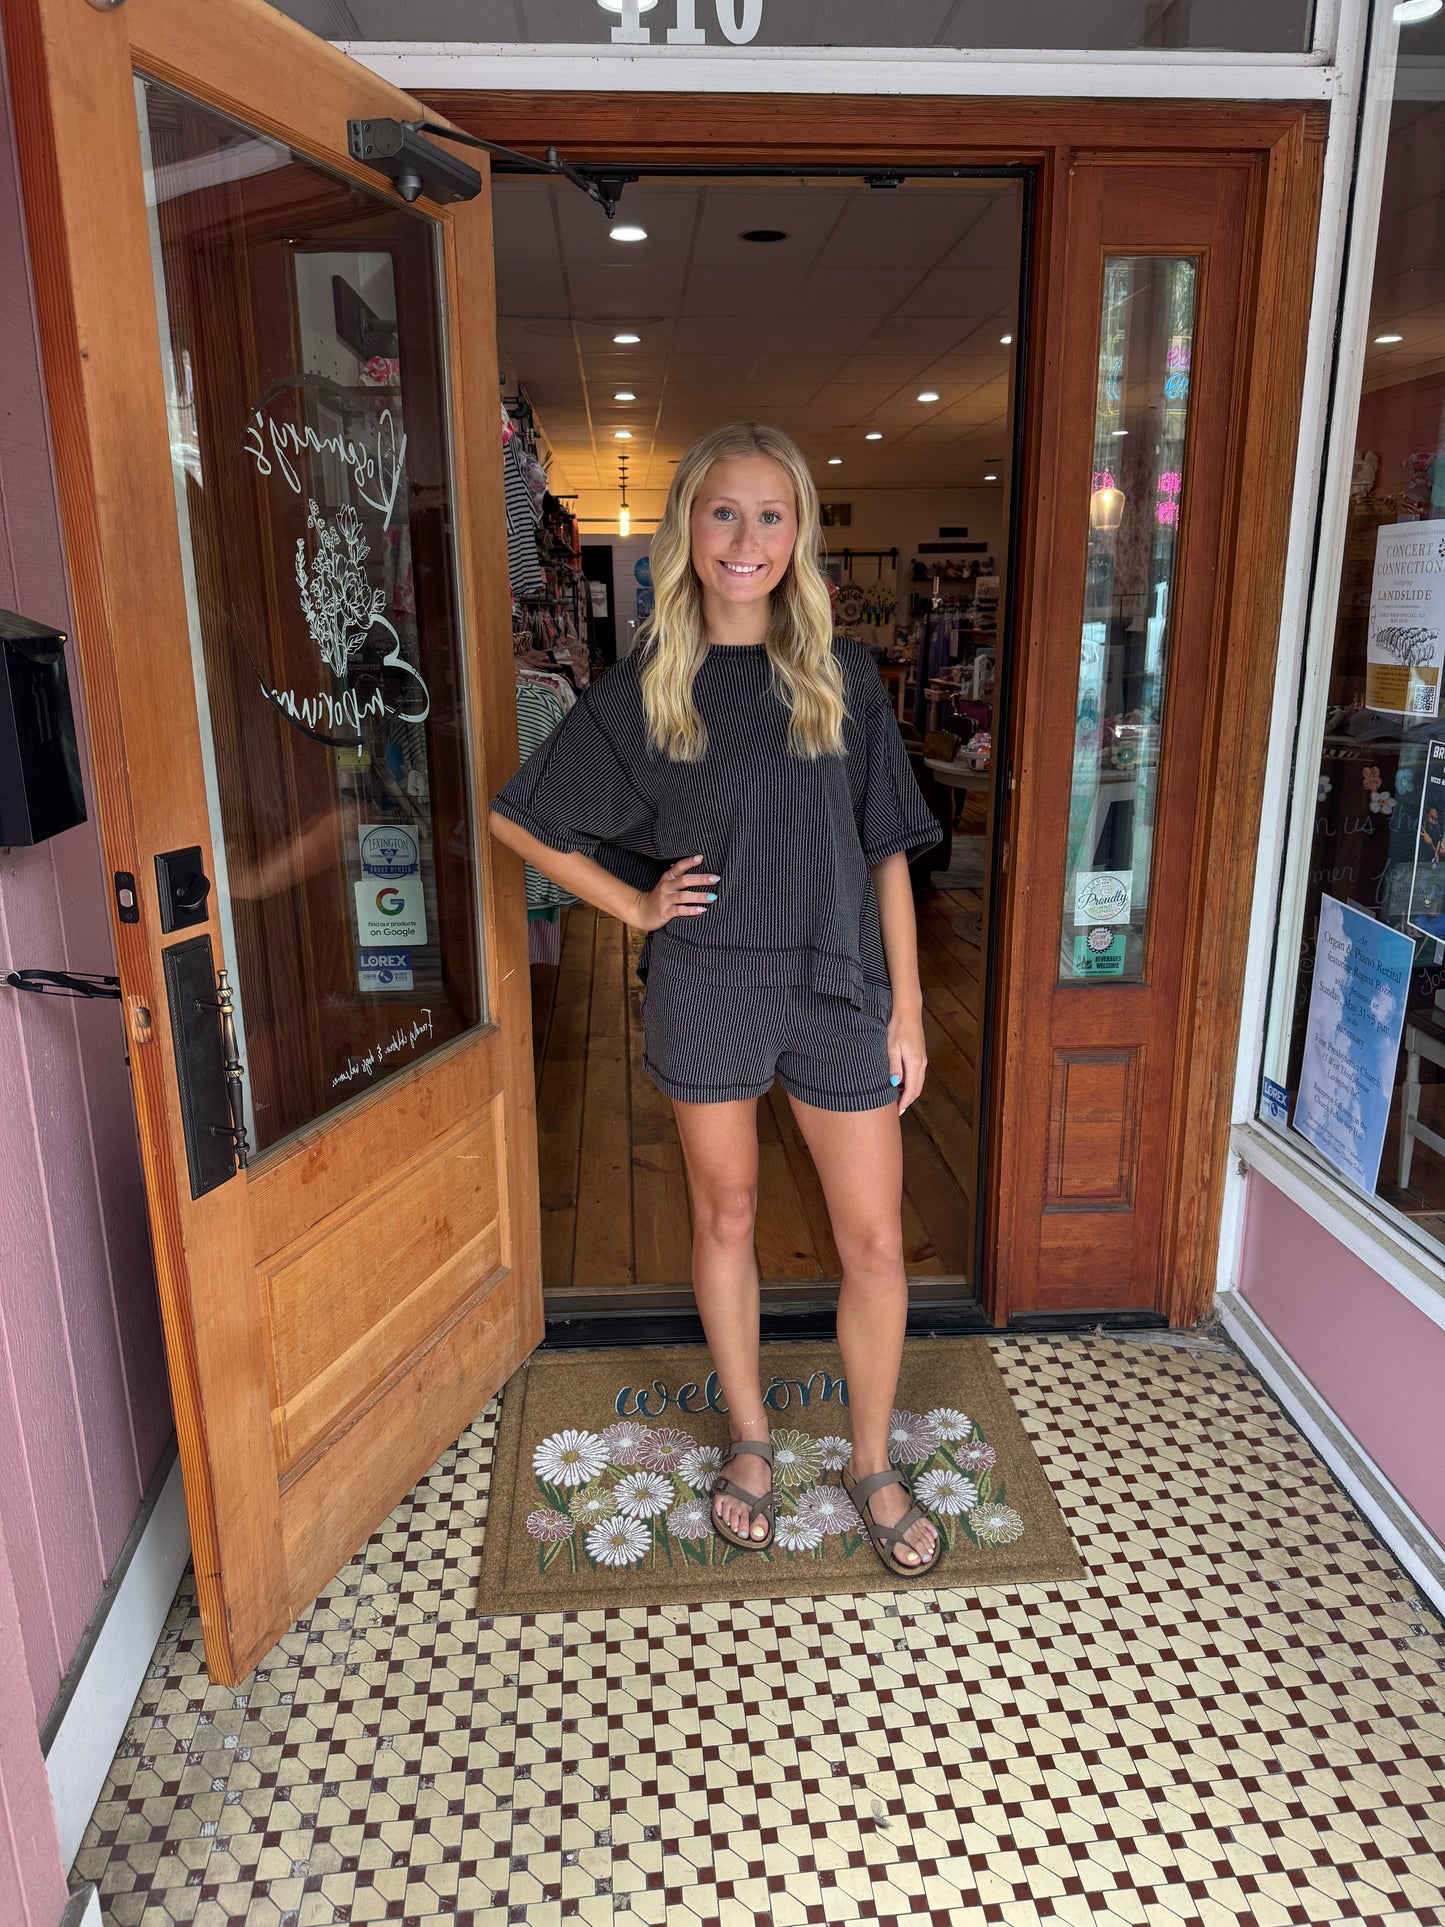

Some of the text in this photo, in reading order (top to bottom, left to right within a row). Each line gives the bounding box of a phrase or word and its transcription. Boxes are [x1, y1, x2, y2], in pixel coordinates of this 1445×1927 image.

[1386, 543, 1434, 558] CONCERT
[1377, 560, 1443, 576] CONNECTION
[1378, 590, 1432, 600] LANDSLIDE
[1433, 746, 1445, 759] BR
[1344, 816, 1374, 834] us
[368, 838, 408, 851] LEXINGTON
[376, 887, 405, 916] G
[1078, 890, 1127, 909] Proudly
[384, 928, 416, 938] Google
[360, 955, 407, 967] LOREX
[1323, 929, 1345, 955] Organ
[1346, 941, 1353, 955] &
[1354, 946, 1375, 969] Piano
[1376, 958, 1402, 985] Recital
[1326, 949, 1352, 976] featuring
[1353, 965, 1374, 989] Regina
[1318, 979, 1343, 1007] Sunday,
[1343, 995, 1358, 1016] May
[1376, 1018, 1392, 1039] p.m.
[1335, 1018, 1365, 1051] Sanctuary
[1326, 1040, 1359, 1075] Presbyterian
[1359, 1064, 1381, 1089] Church
[1264, 1081, 1288, 1107] LOREX
[1349, 1085, 1360, 1101] NC
[614, 1369, 850, 1418] welom
